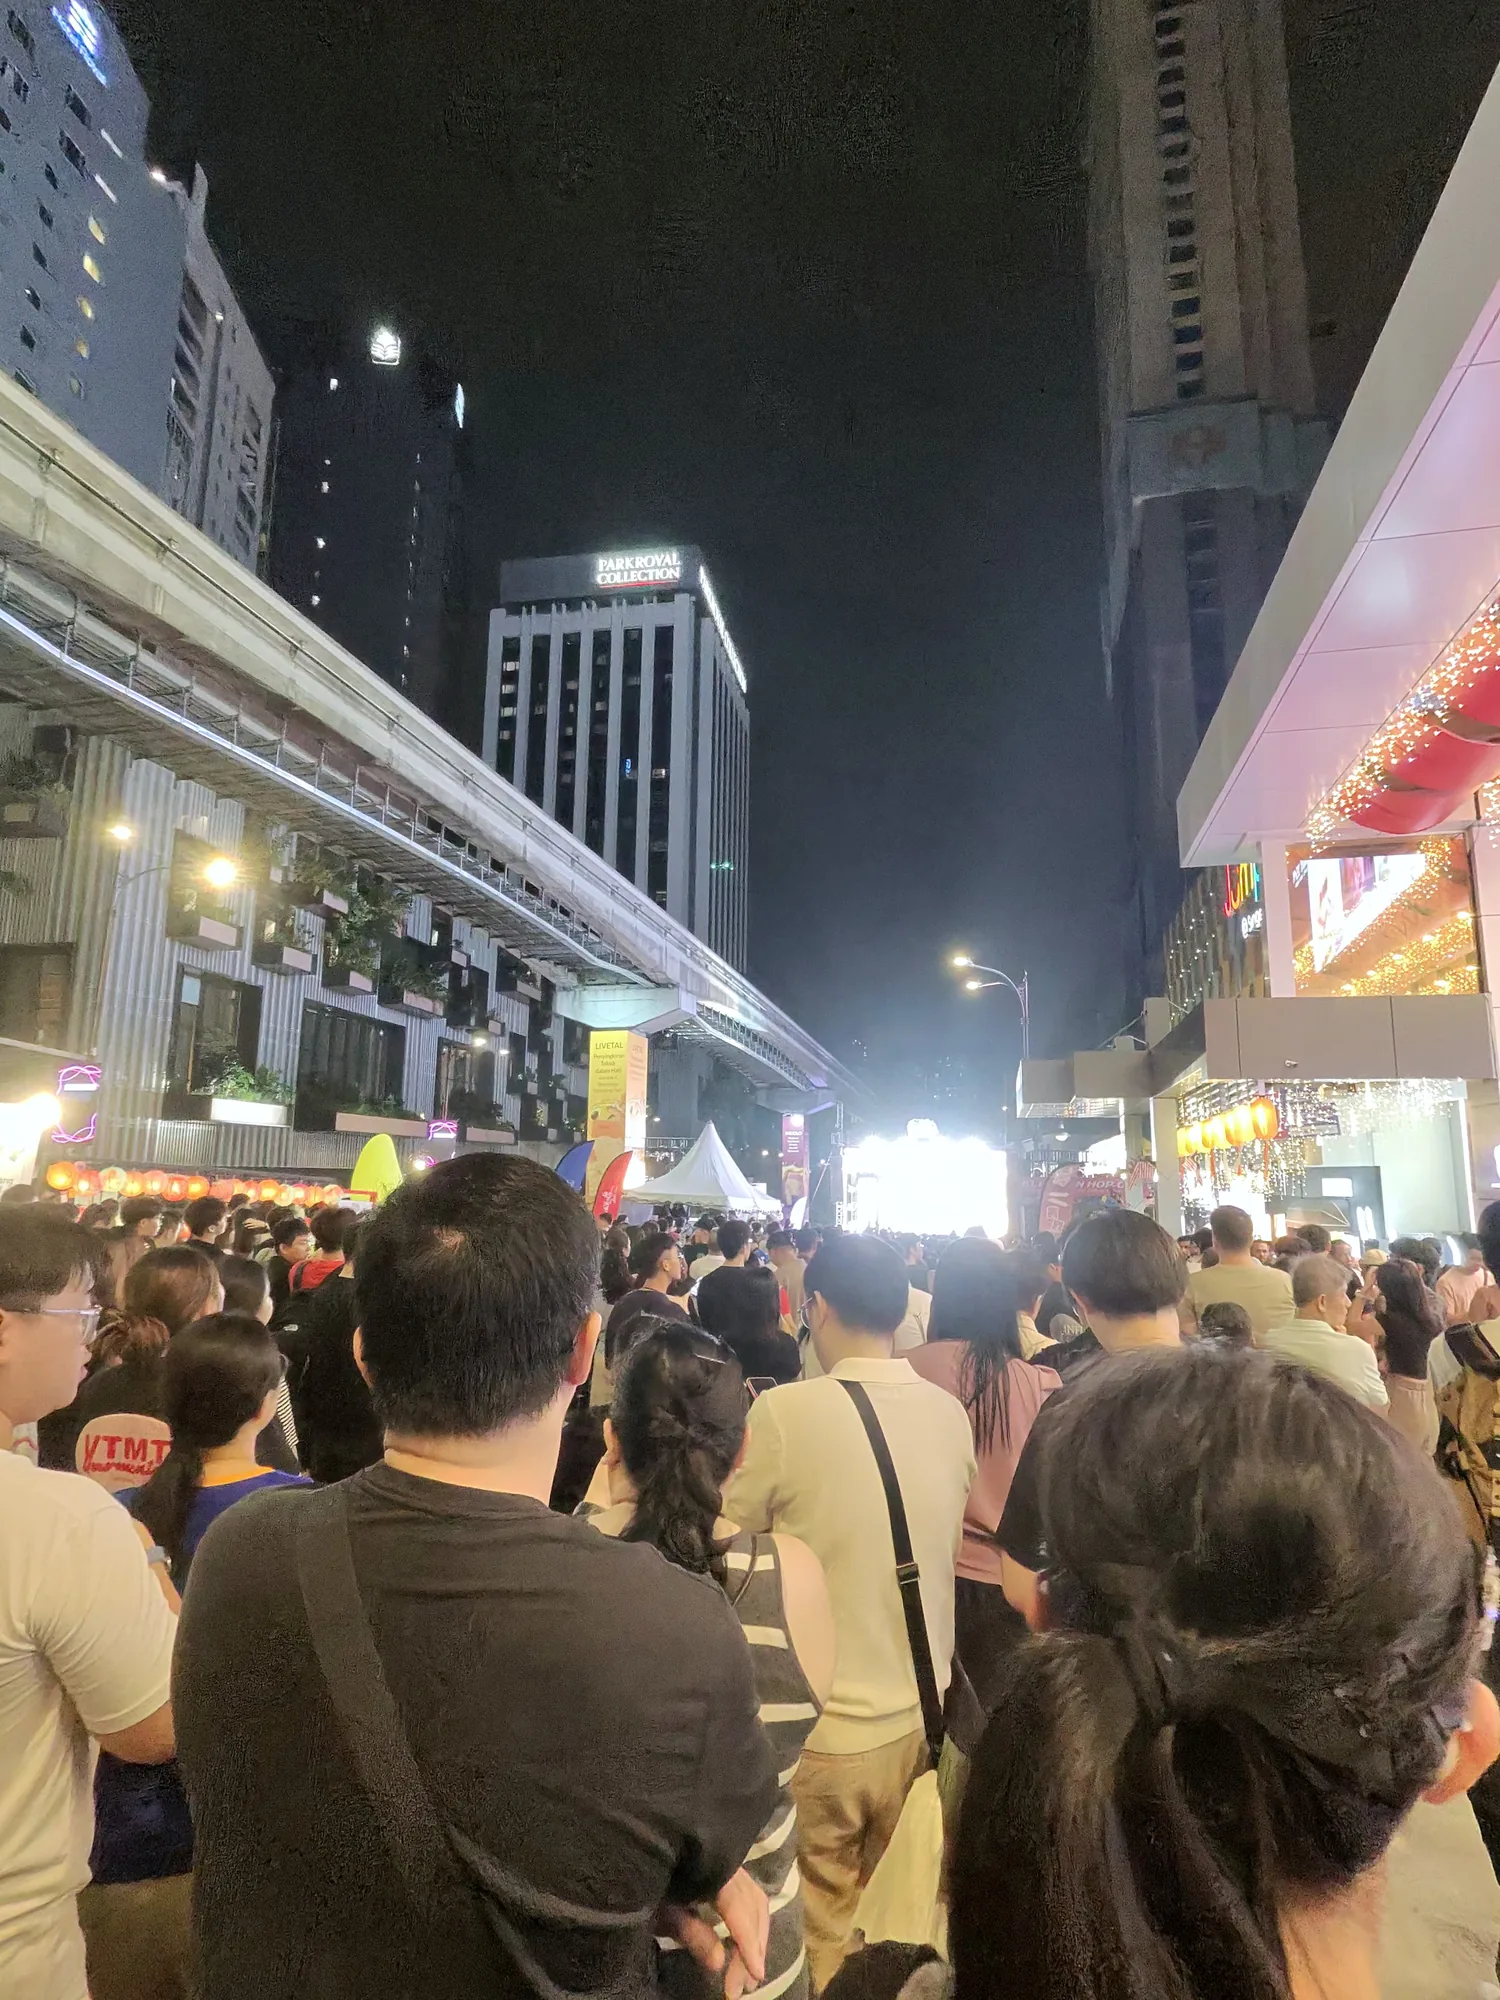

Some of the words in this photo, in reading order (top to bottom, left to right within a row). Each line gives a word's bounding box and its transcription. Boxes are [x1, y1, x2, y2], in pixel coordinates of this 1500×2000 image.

[598, 552, 681, 572] PARKROYAL
[596, 566, 681, 585] COLLECTION
[595, 1042, 624, 1050] LIVETAL
